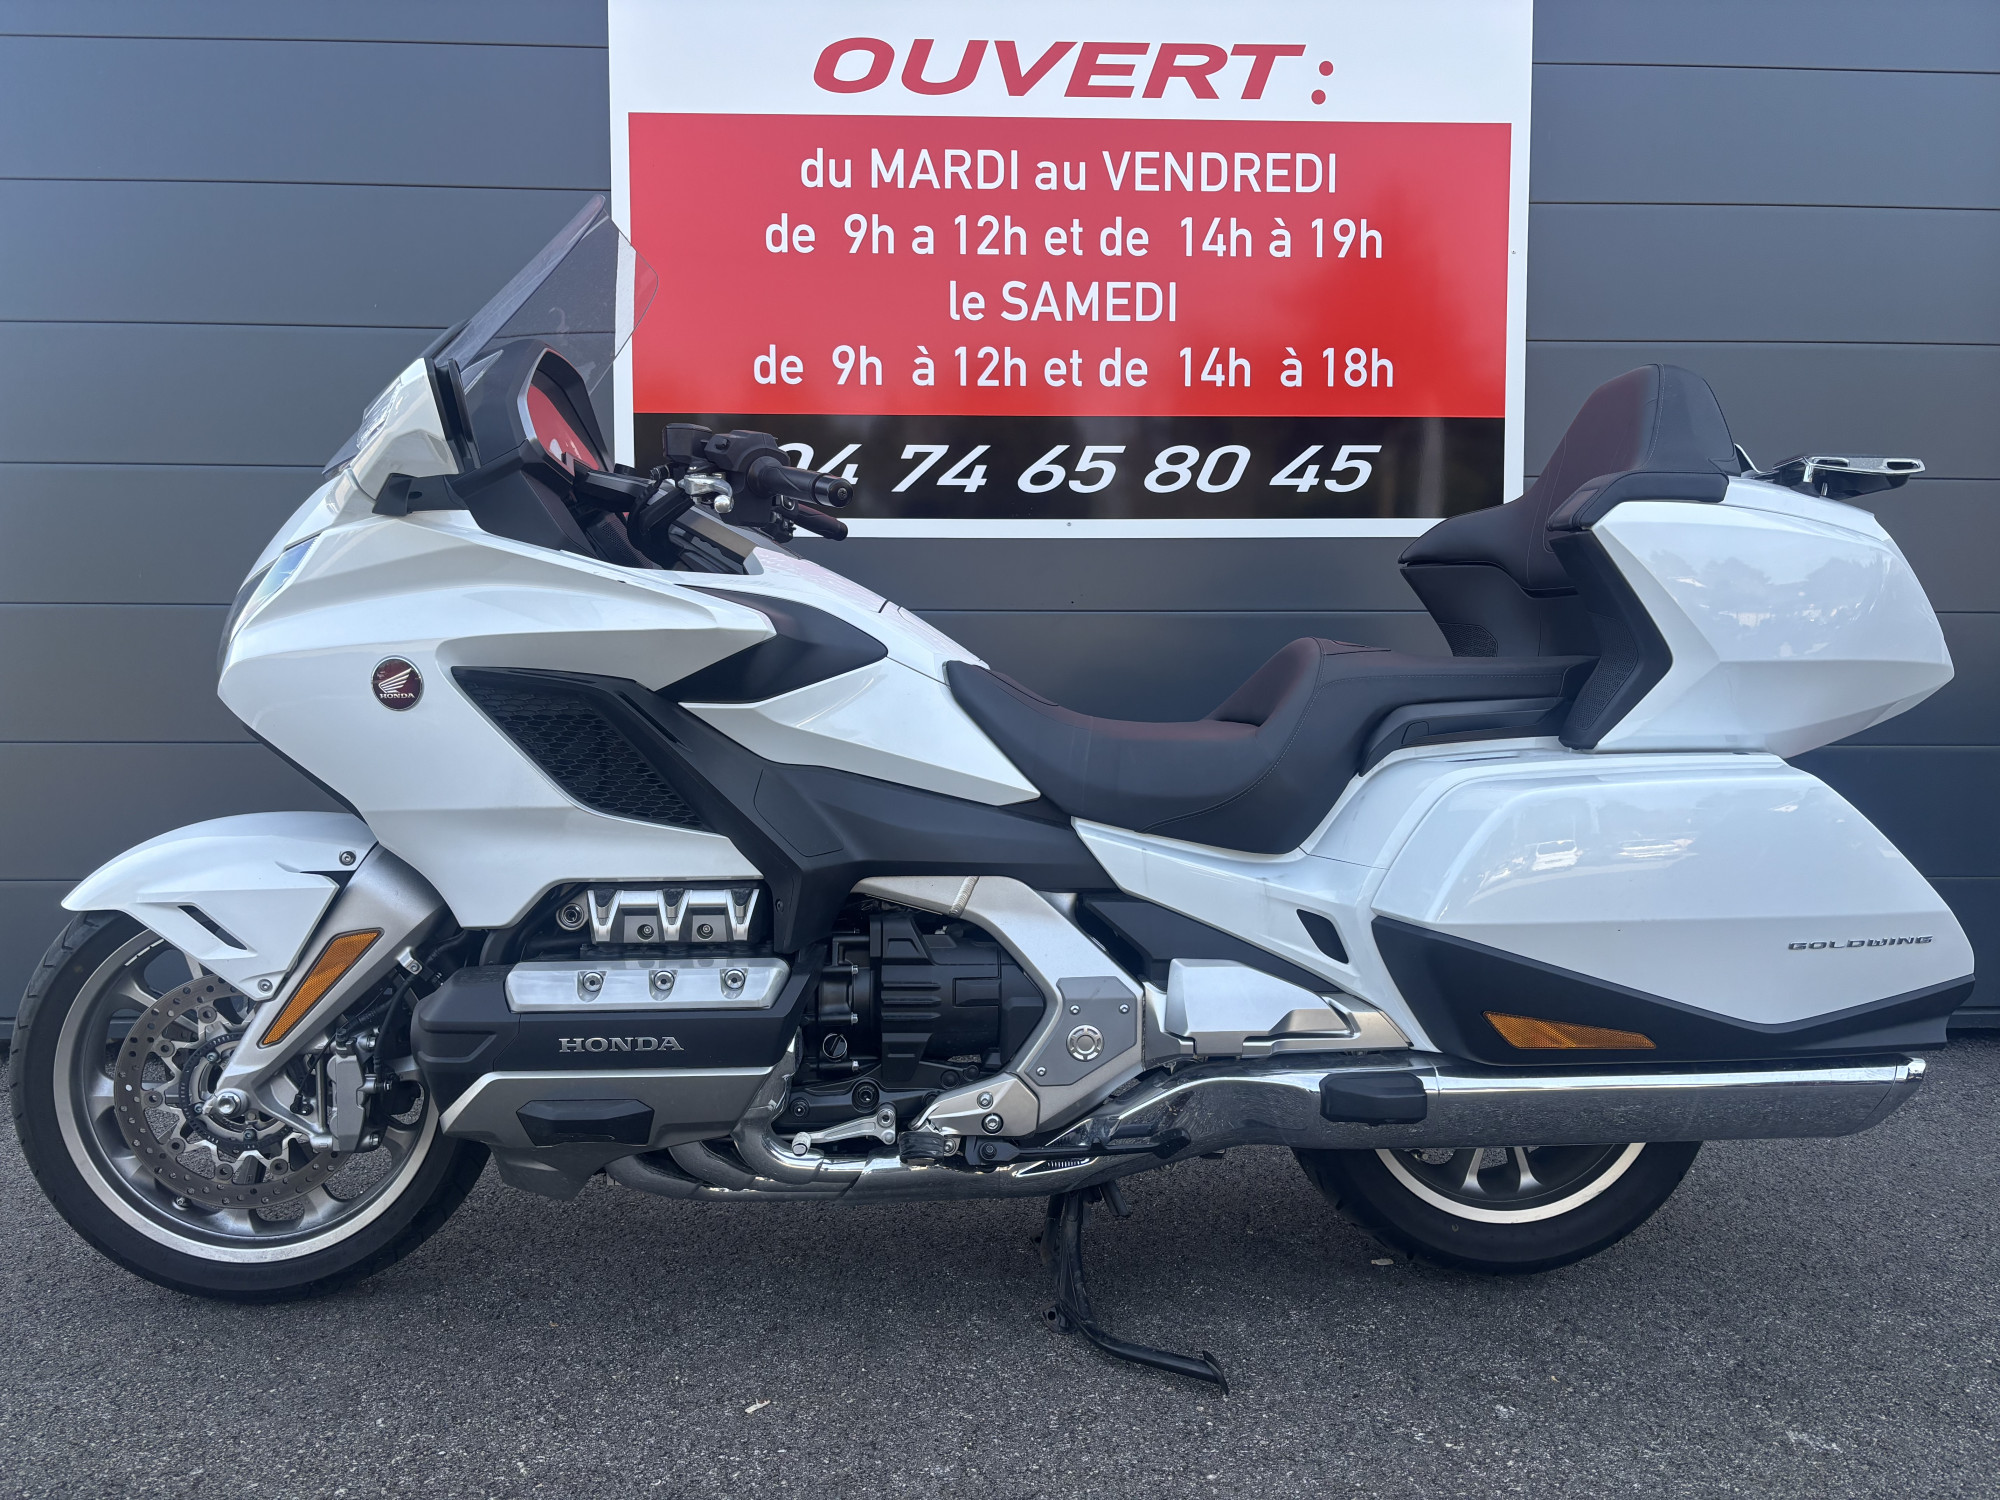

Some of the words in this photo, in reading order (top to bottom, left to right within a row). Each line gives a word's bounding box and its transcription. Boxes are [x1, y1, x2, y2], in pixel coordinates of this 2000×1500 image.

[800, 147, 852, 189] du
[871, 148, 1018, 190] MARDI
[1034, 160, 1086, 191] au
[1102, 150, 1336, 193] VENDREDI
[765, 212, 816, 254] de
[844, 213, 895, 254] 9h
[911, 225, 934, 255] a
[954, 214, 1027, 256] 12h
[1044, 218, 1084, 256] et
[1099, 216, 1149, 257] de
[1180, 216, 1252, 257] 14h
[1268, 217, 1291, 258] à
[1311, 218, 1383, 259] 19h
[949, 280, 986, 321] le
[1000, 280, 1177, 322] SAMEDI
[753, 343, 804, 385] de
[832, 344, 883, 386] 9h
[912, 345, 935, 387] à
[954, 346, 1027, 387] 12h
[1044, 349, 1083, 387] et
[1099, 346, 1148, 388] de
[1179, 347, 1251, 387] 14h
[1280, 347, 1303, 388] à
[1322, 347, 1394, 388] 18h
[891, 444, 991, 493] 74
[1017, 444, 1127, 494] 65
[1143, 444, 1251, 494] 80
[1269, 444, 1383, 493] 45
[1788, 935, 1934, 950] GOLDWING
[558, 1036, 685, 1054] HONDA
